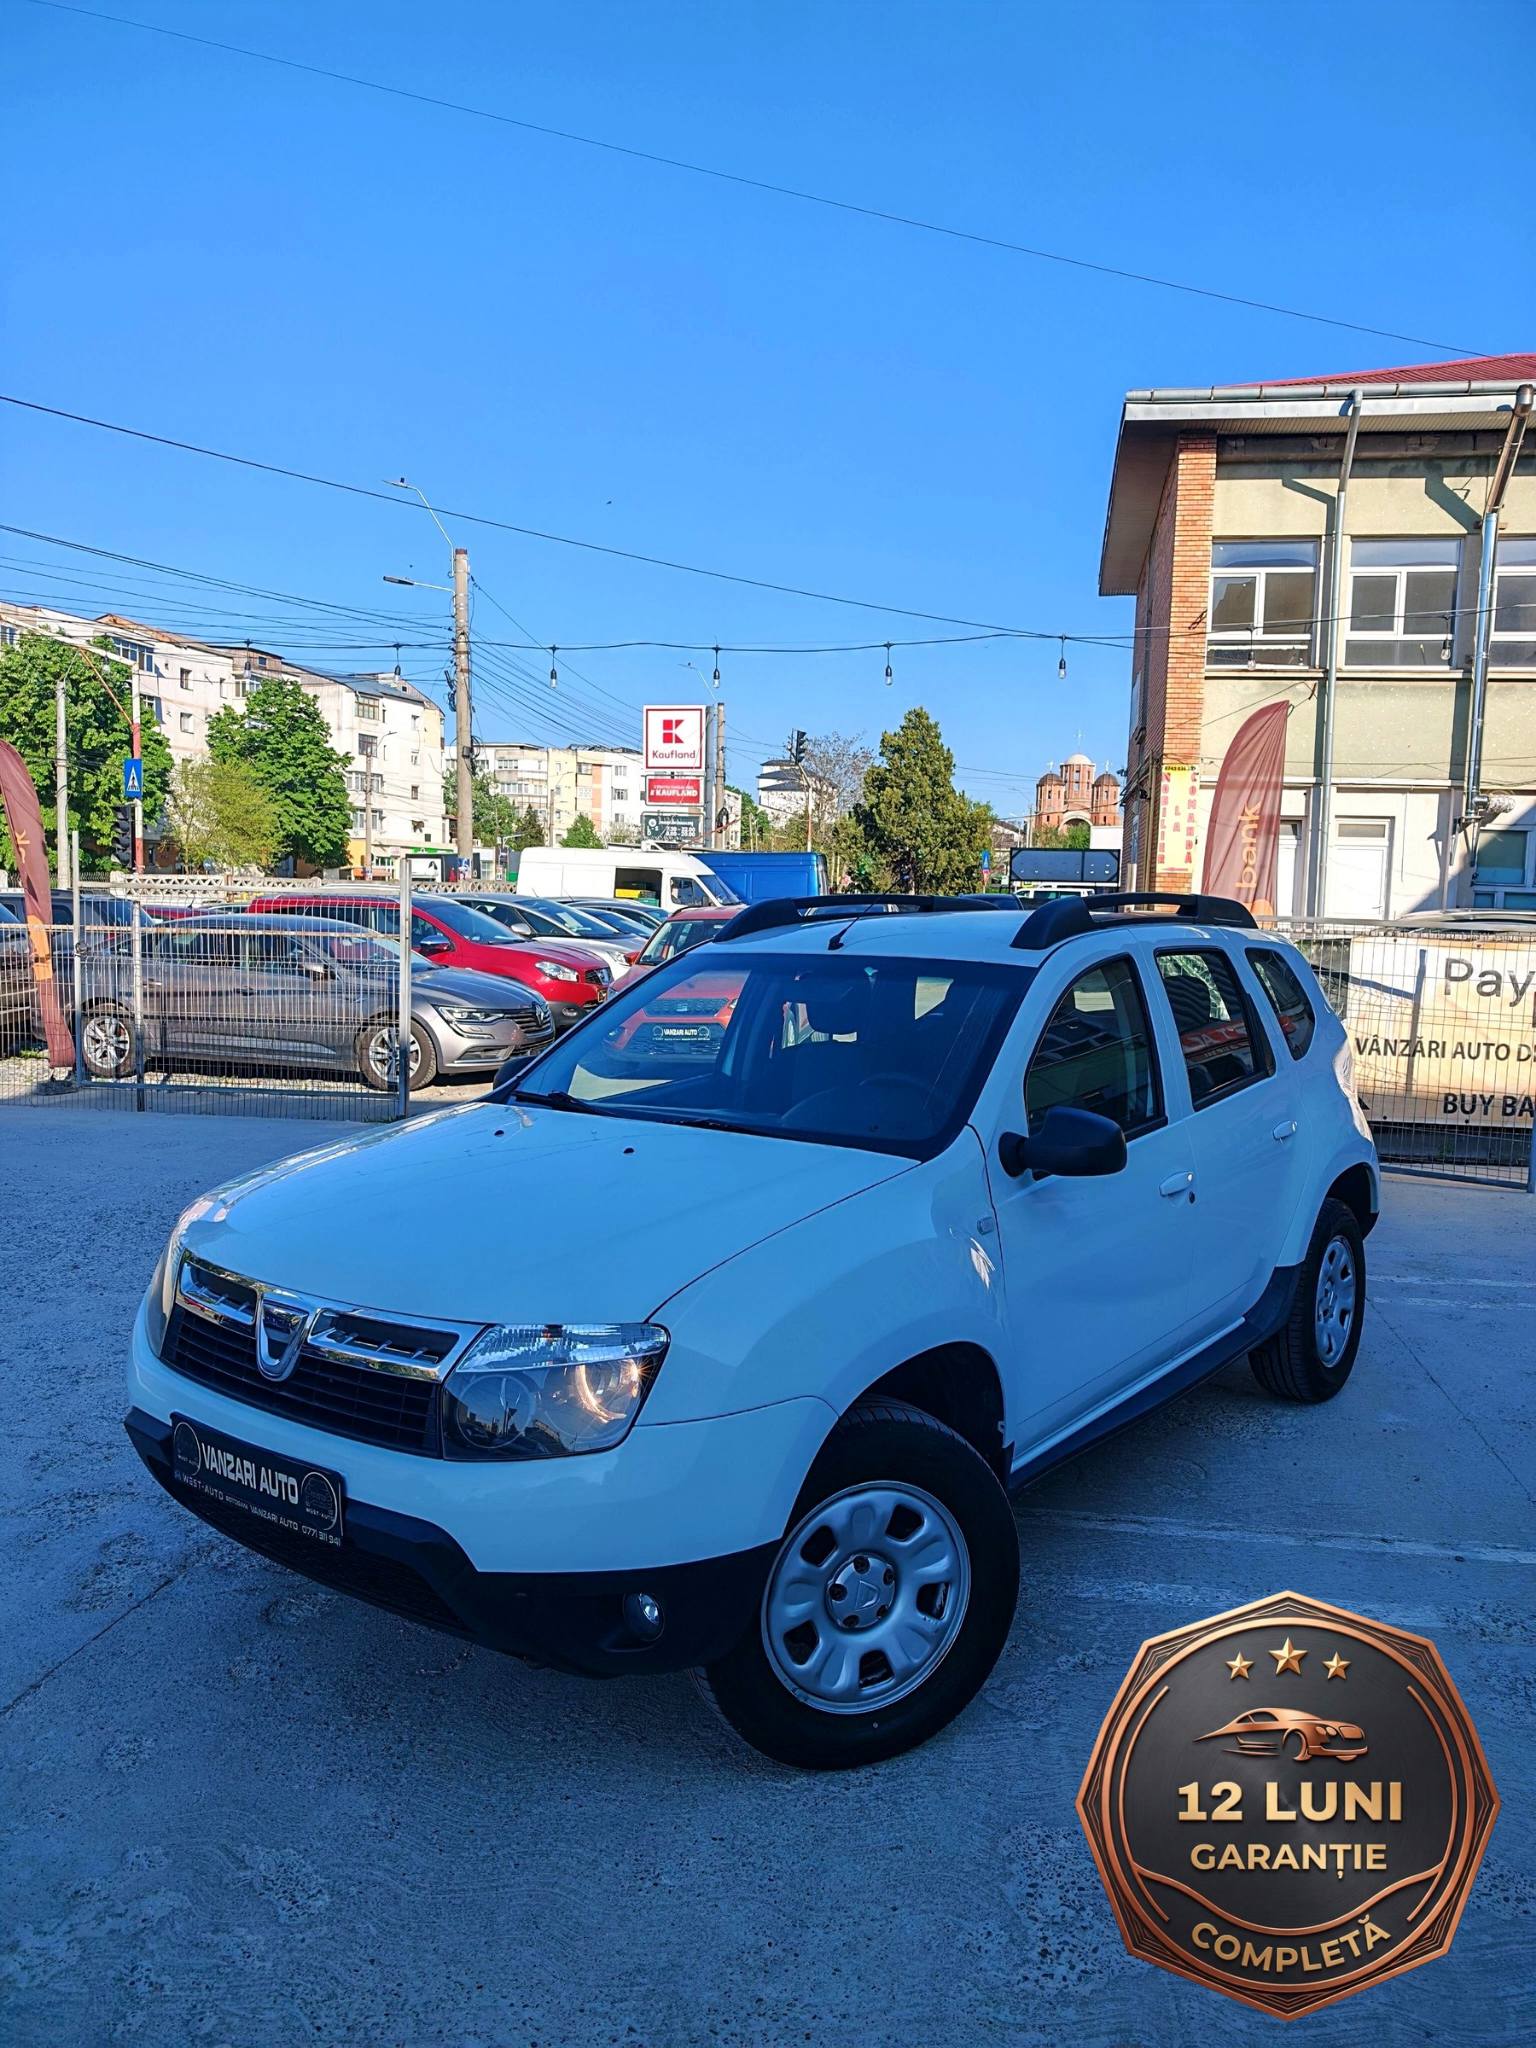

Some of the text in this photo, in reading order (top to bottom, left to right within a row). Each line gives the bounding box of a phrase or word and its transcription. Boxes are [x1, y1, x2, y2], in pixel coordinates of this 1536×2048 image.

[652, 750, 696, 759] Kaufland
[1235, 800, 1262, 888] bank
[1355, 1034, 1536, 1062] VÂNZĂRI AUTO D
[1443, 1092, 1495, 1116] BUY
[201, 1443, 299, 1505] VANZARI AUTO
[183, 1474, 224, 1501] WEST-AUTO
[250, 1504, 279, 1524] VANZARI
[279, 1518, 299, 1532] AUTO
